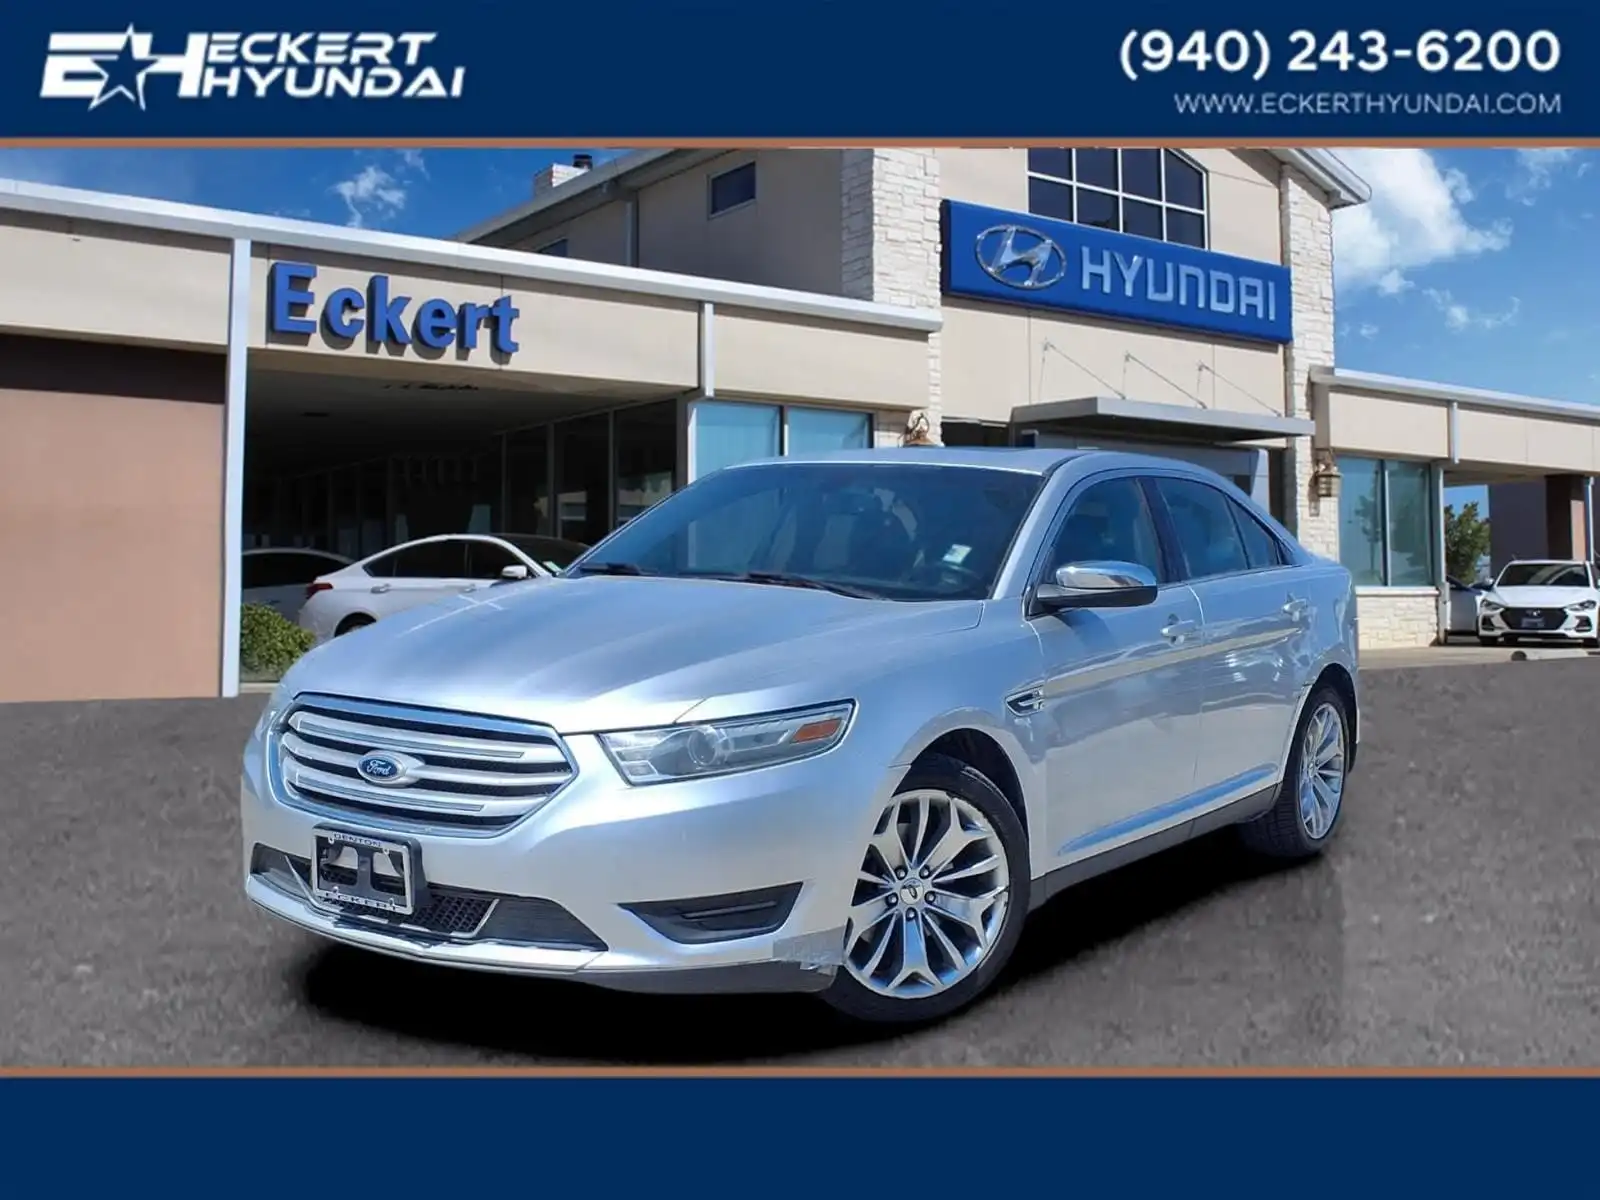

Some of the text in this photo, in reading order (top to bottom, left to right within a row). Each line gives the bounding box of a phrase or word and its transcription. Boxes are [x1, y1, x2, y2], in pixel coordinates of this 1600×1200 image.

[270, 261, 520, 355] Eckert
[1081, 246, 1276, 322] HYUNDAI
[366, 759, 392, 776] Ford
